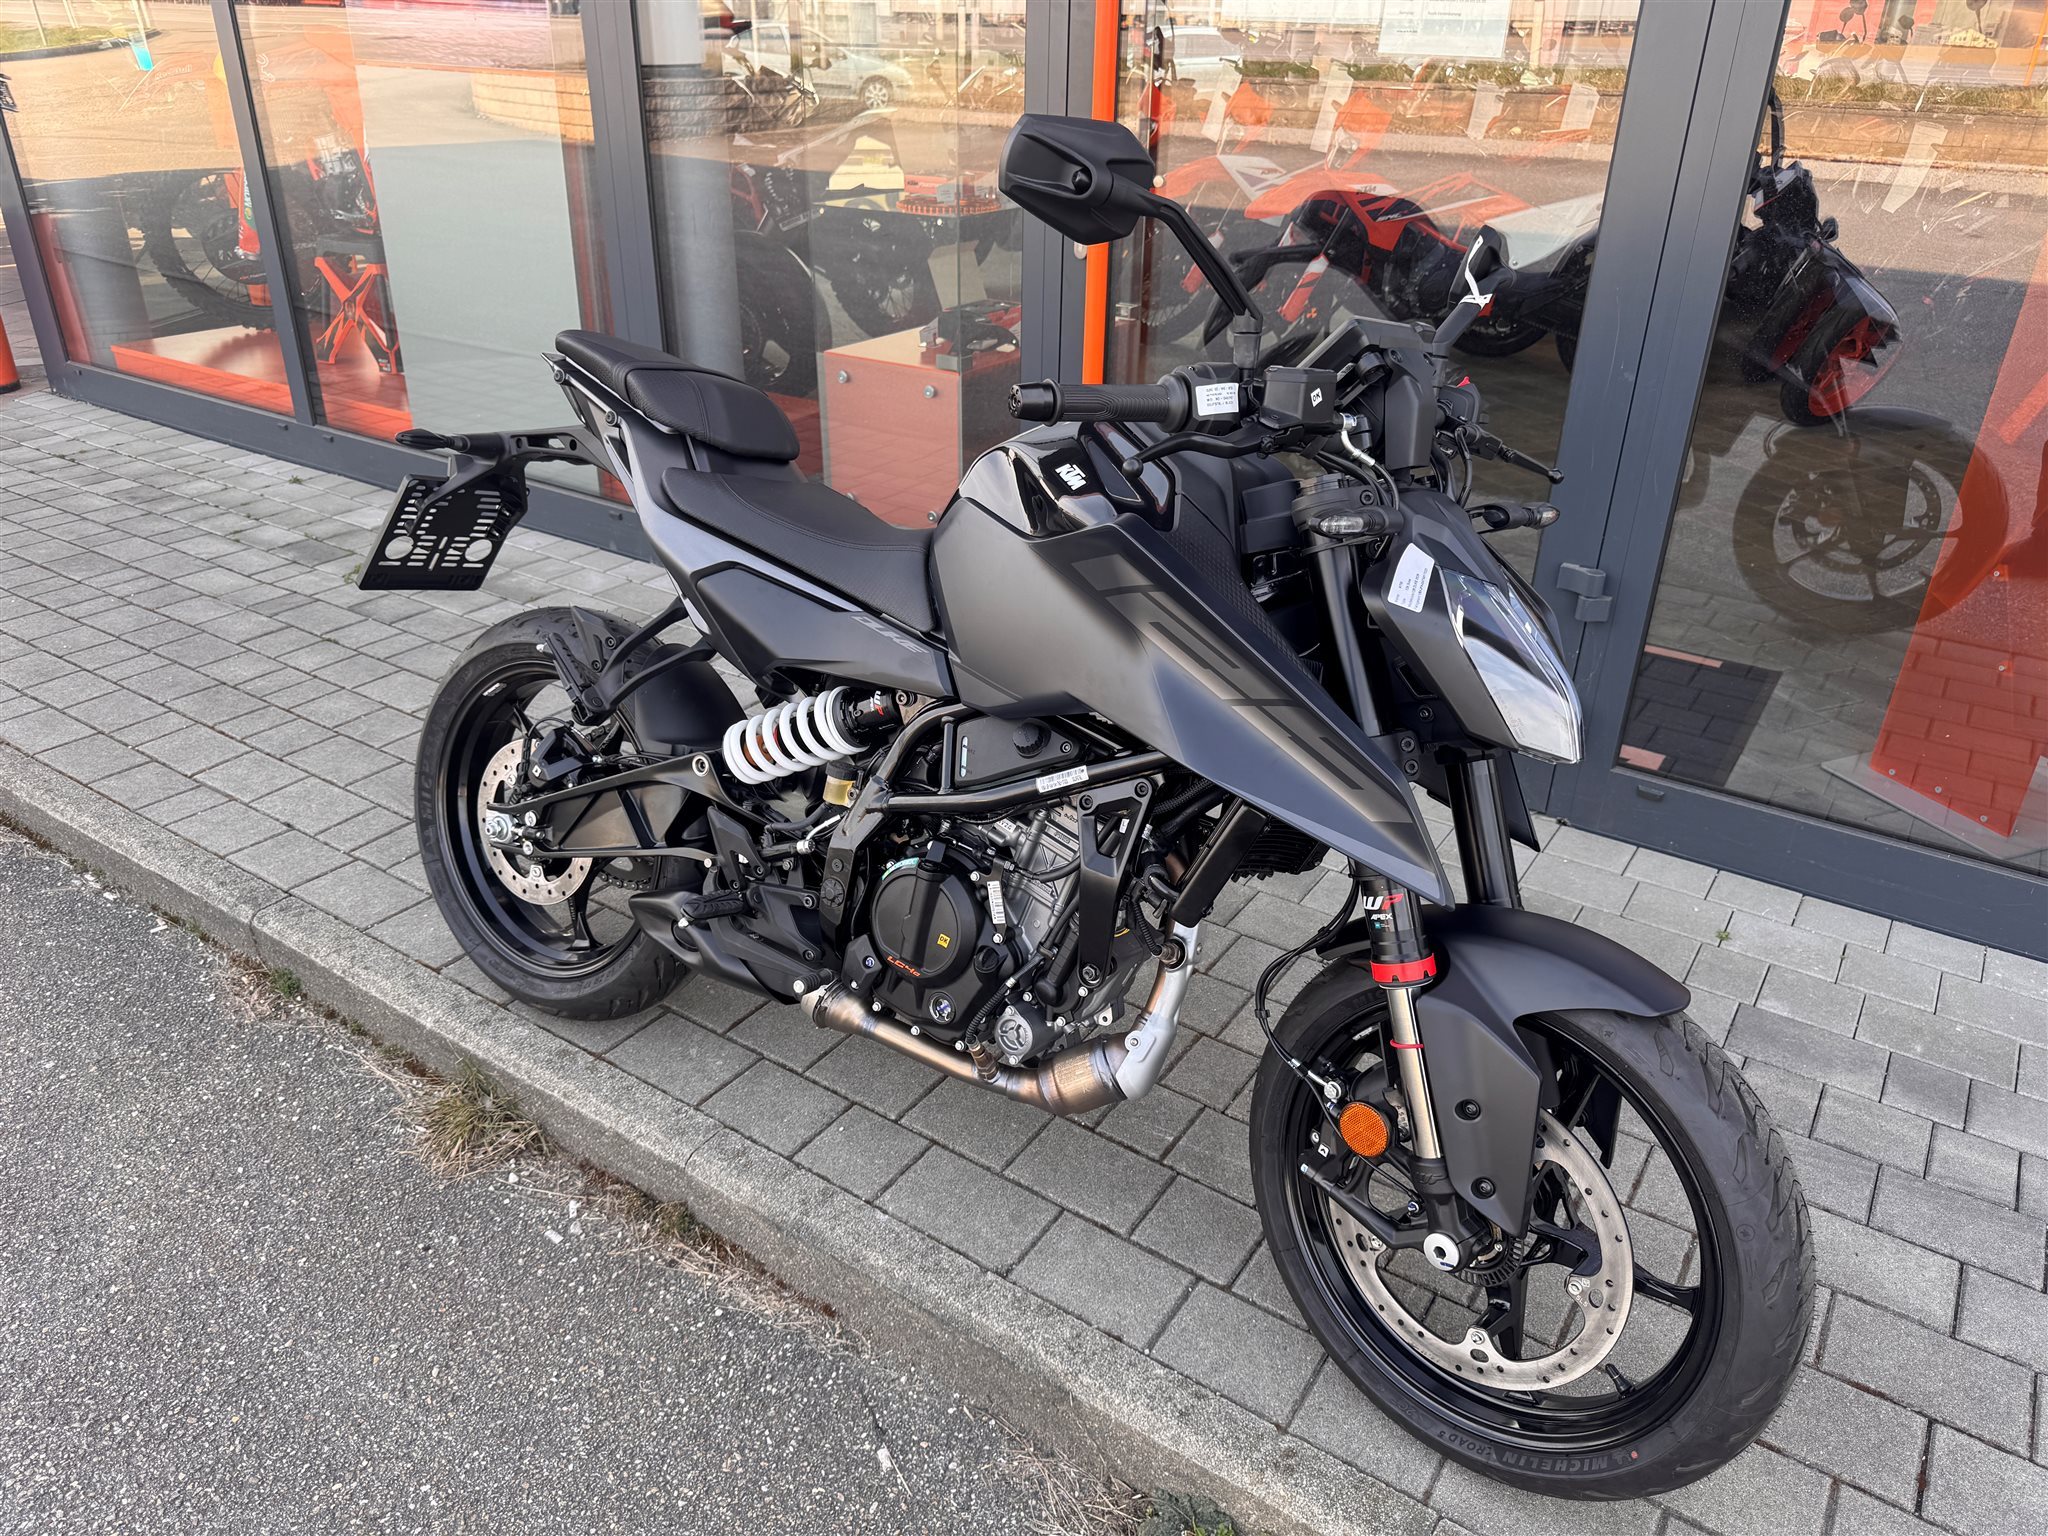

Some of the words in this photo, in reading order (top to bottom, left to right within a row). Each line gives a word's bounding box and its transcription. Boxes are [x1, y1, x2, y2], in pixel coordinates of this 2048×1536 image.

[1055, 463, 1087, 491] KTM
[850, 616, 930, 653] DUKE
[1363, 893, 1404, 911] WP
[1370, 913, 1393, 921] APEX
[1502, 1450, 1608, 1472] MICHELIN
